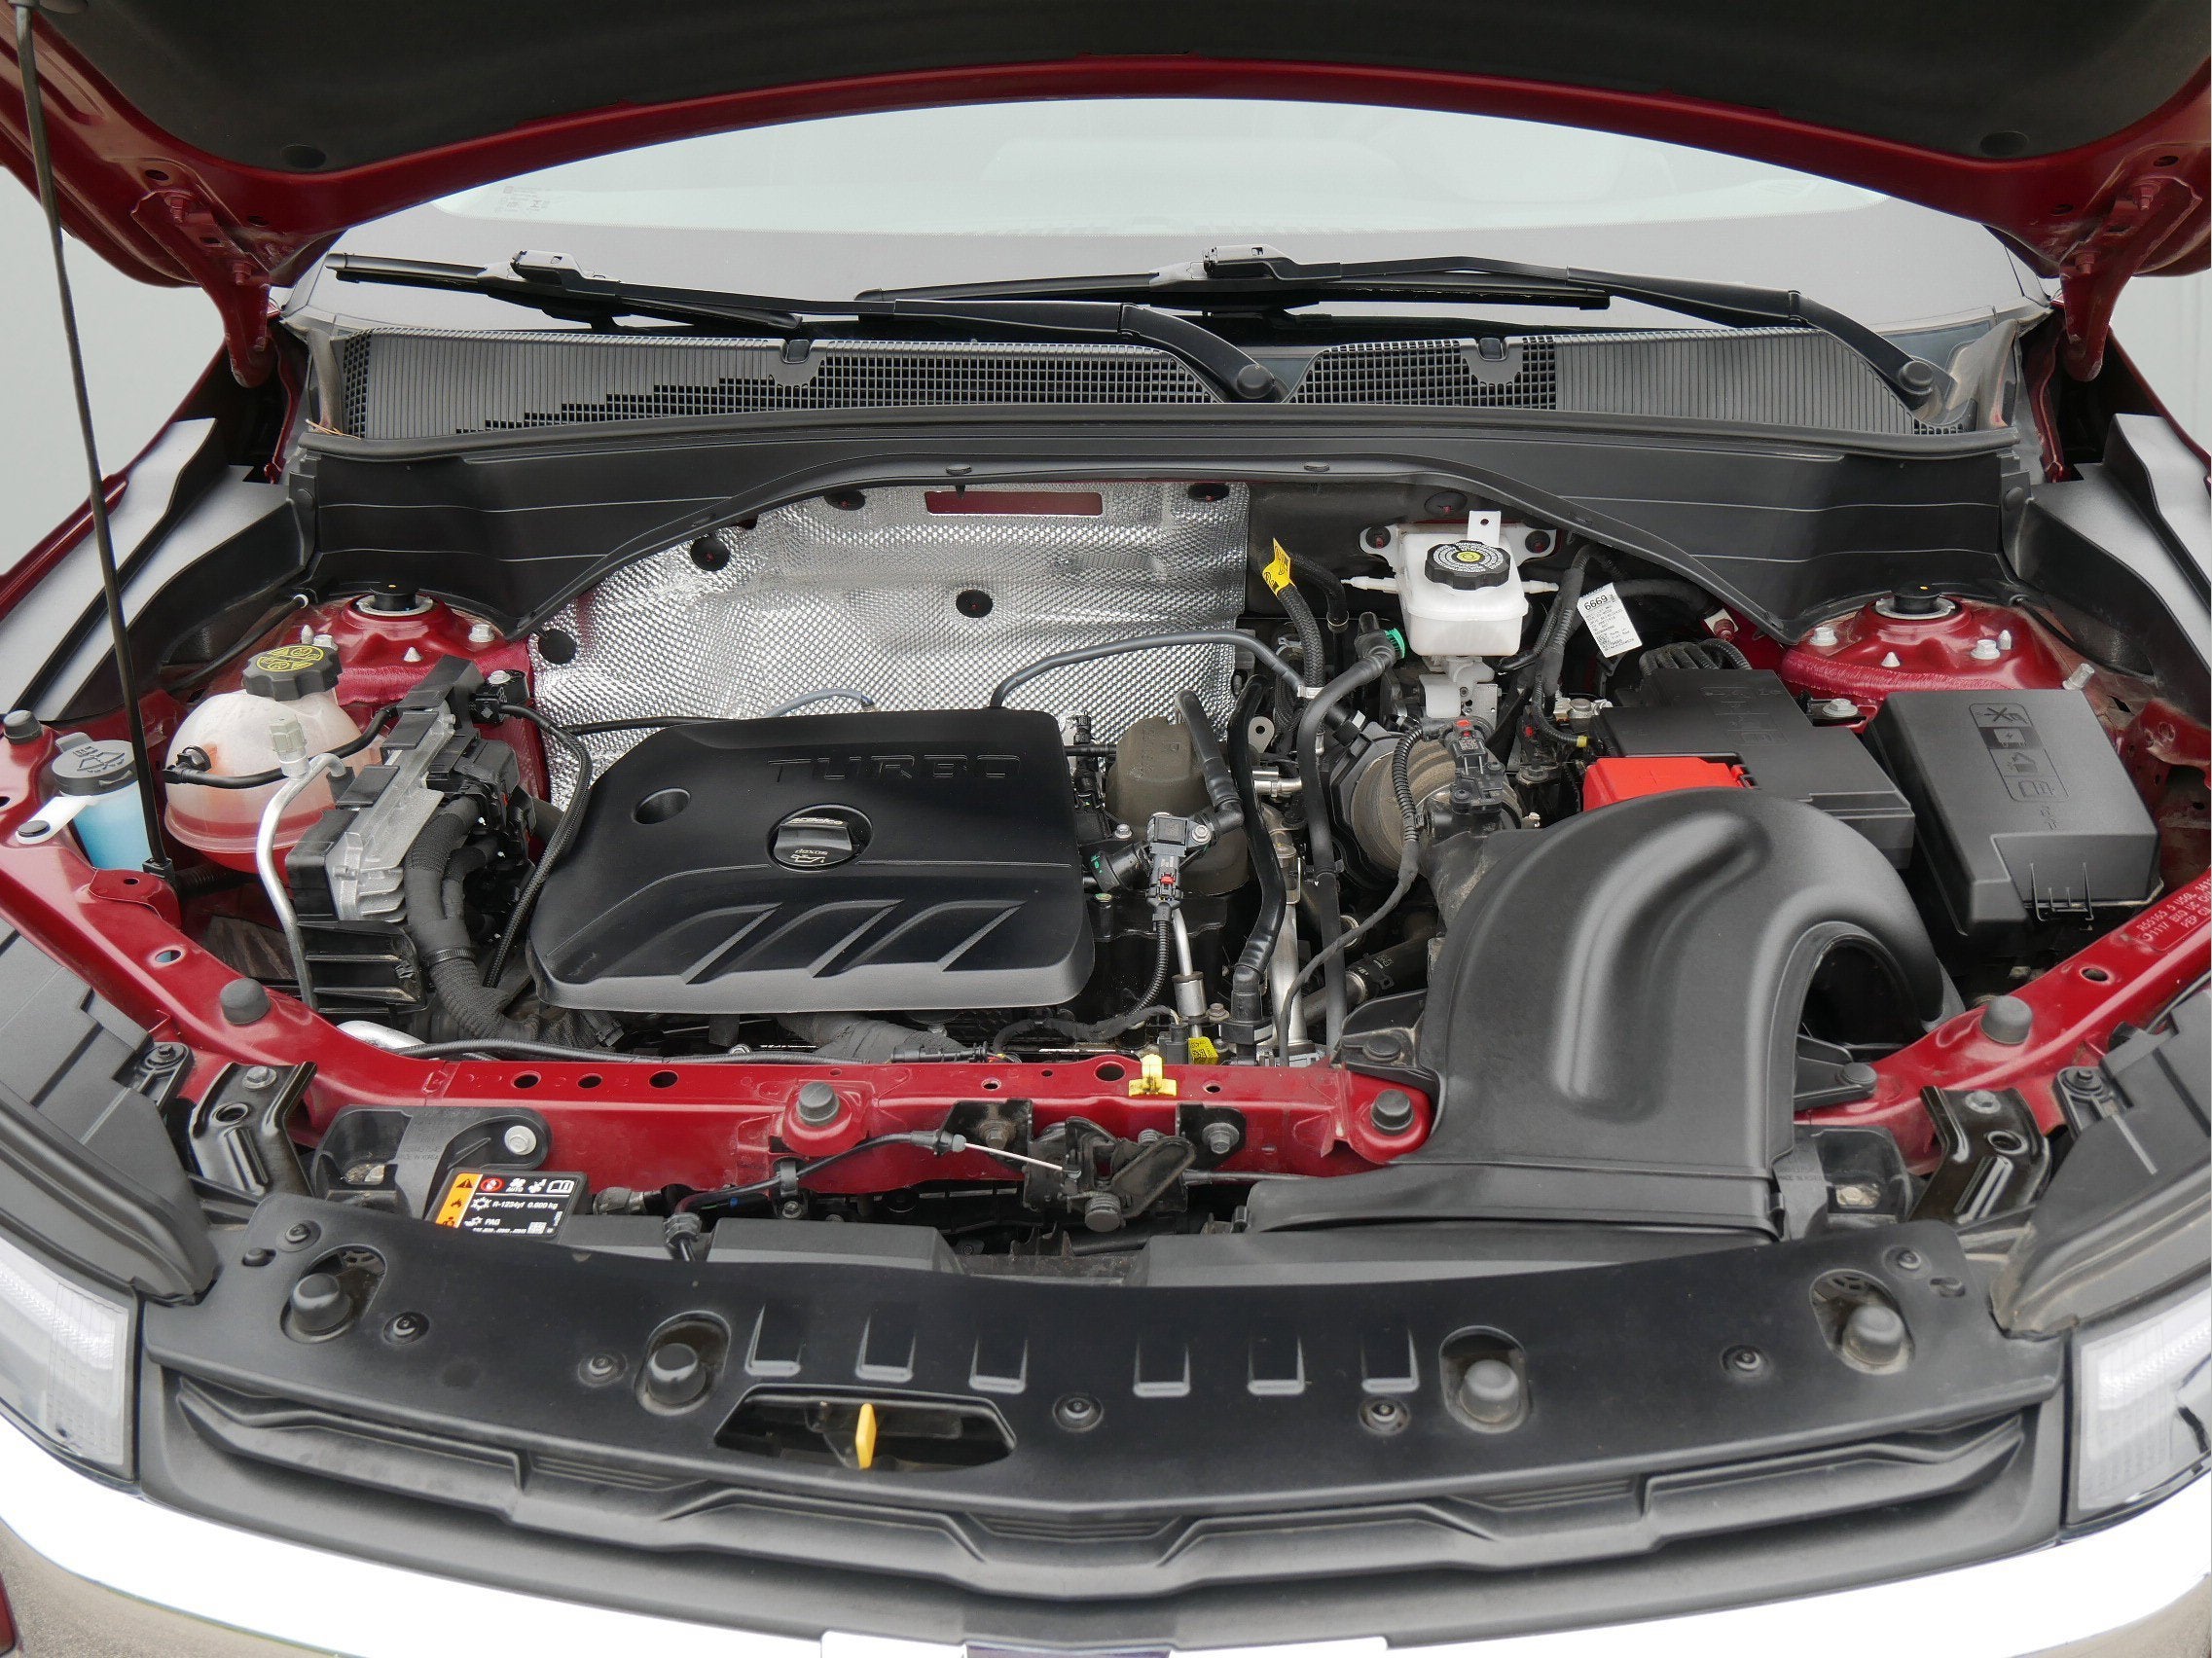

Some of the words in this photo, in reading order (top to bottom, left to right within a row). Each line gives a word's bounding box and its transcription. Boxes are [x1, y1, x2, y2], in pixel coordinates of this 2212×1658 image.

[1584, 595, 1608, 610] 6669
[768, 754, 1020, 781] TURBO
[548, 1202, 559, 1210] kg
